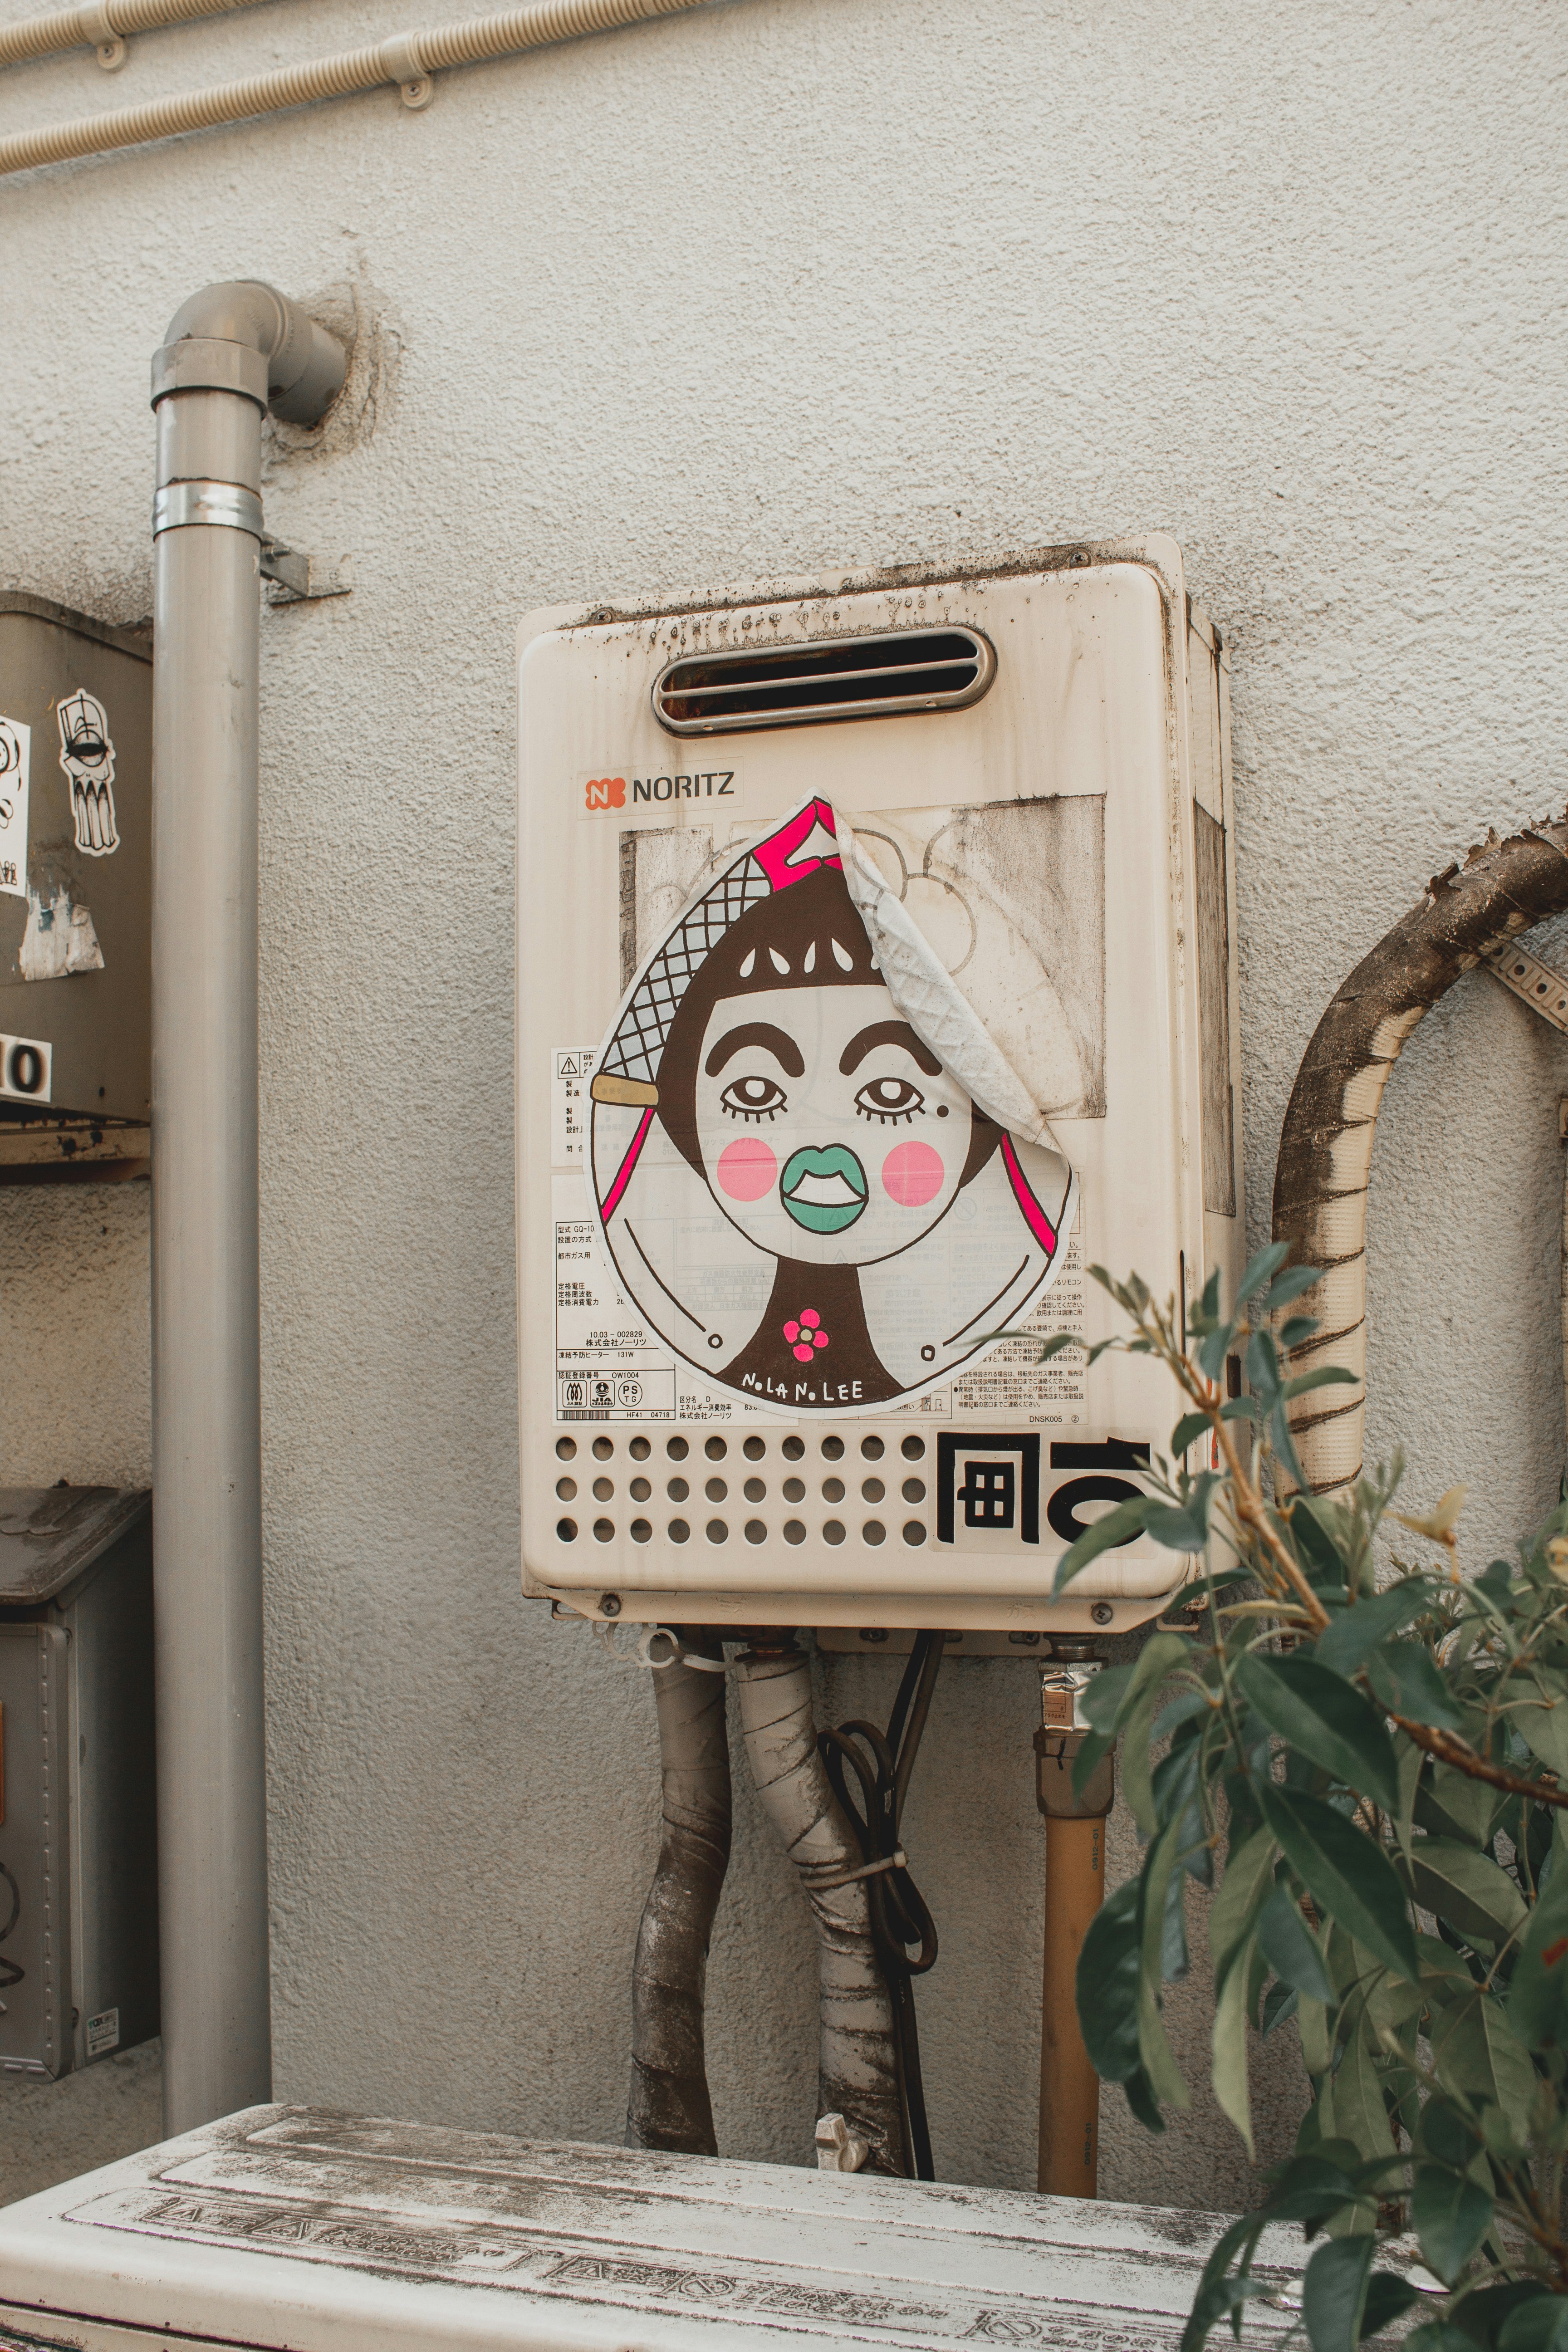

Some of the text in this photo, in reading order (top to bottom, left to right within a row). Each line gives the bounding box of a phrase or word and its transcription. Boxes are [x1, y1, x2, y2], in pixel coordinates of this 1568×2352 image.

[633, 771, 734, 802] NORITZ
[586, 1338, 647, 1347] 株式会社ノーリツ
[680, 1403, 732, 1411] エネルギー消費効率
[680, 1411, 732, 1420] 株式会社ノーリツ
